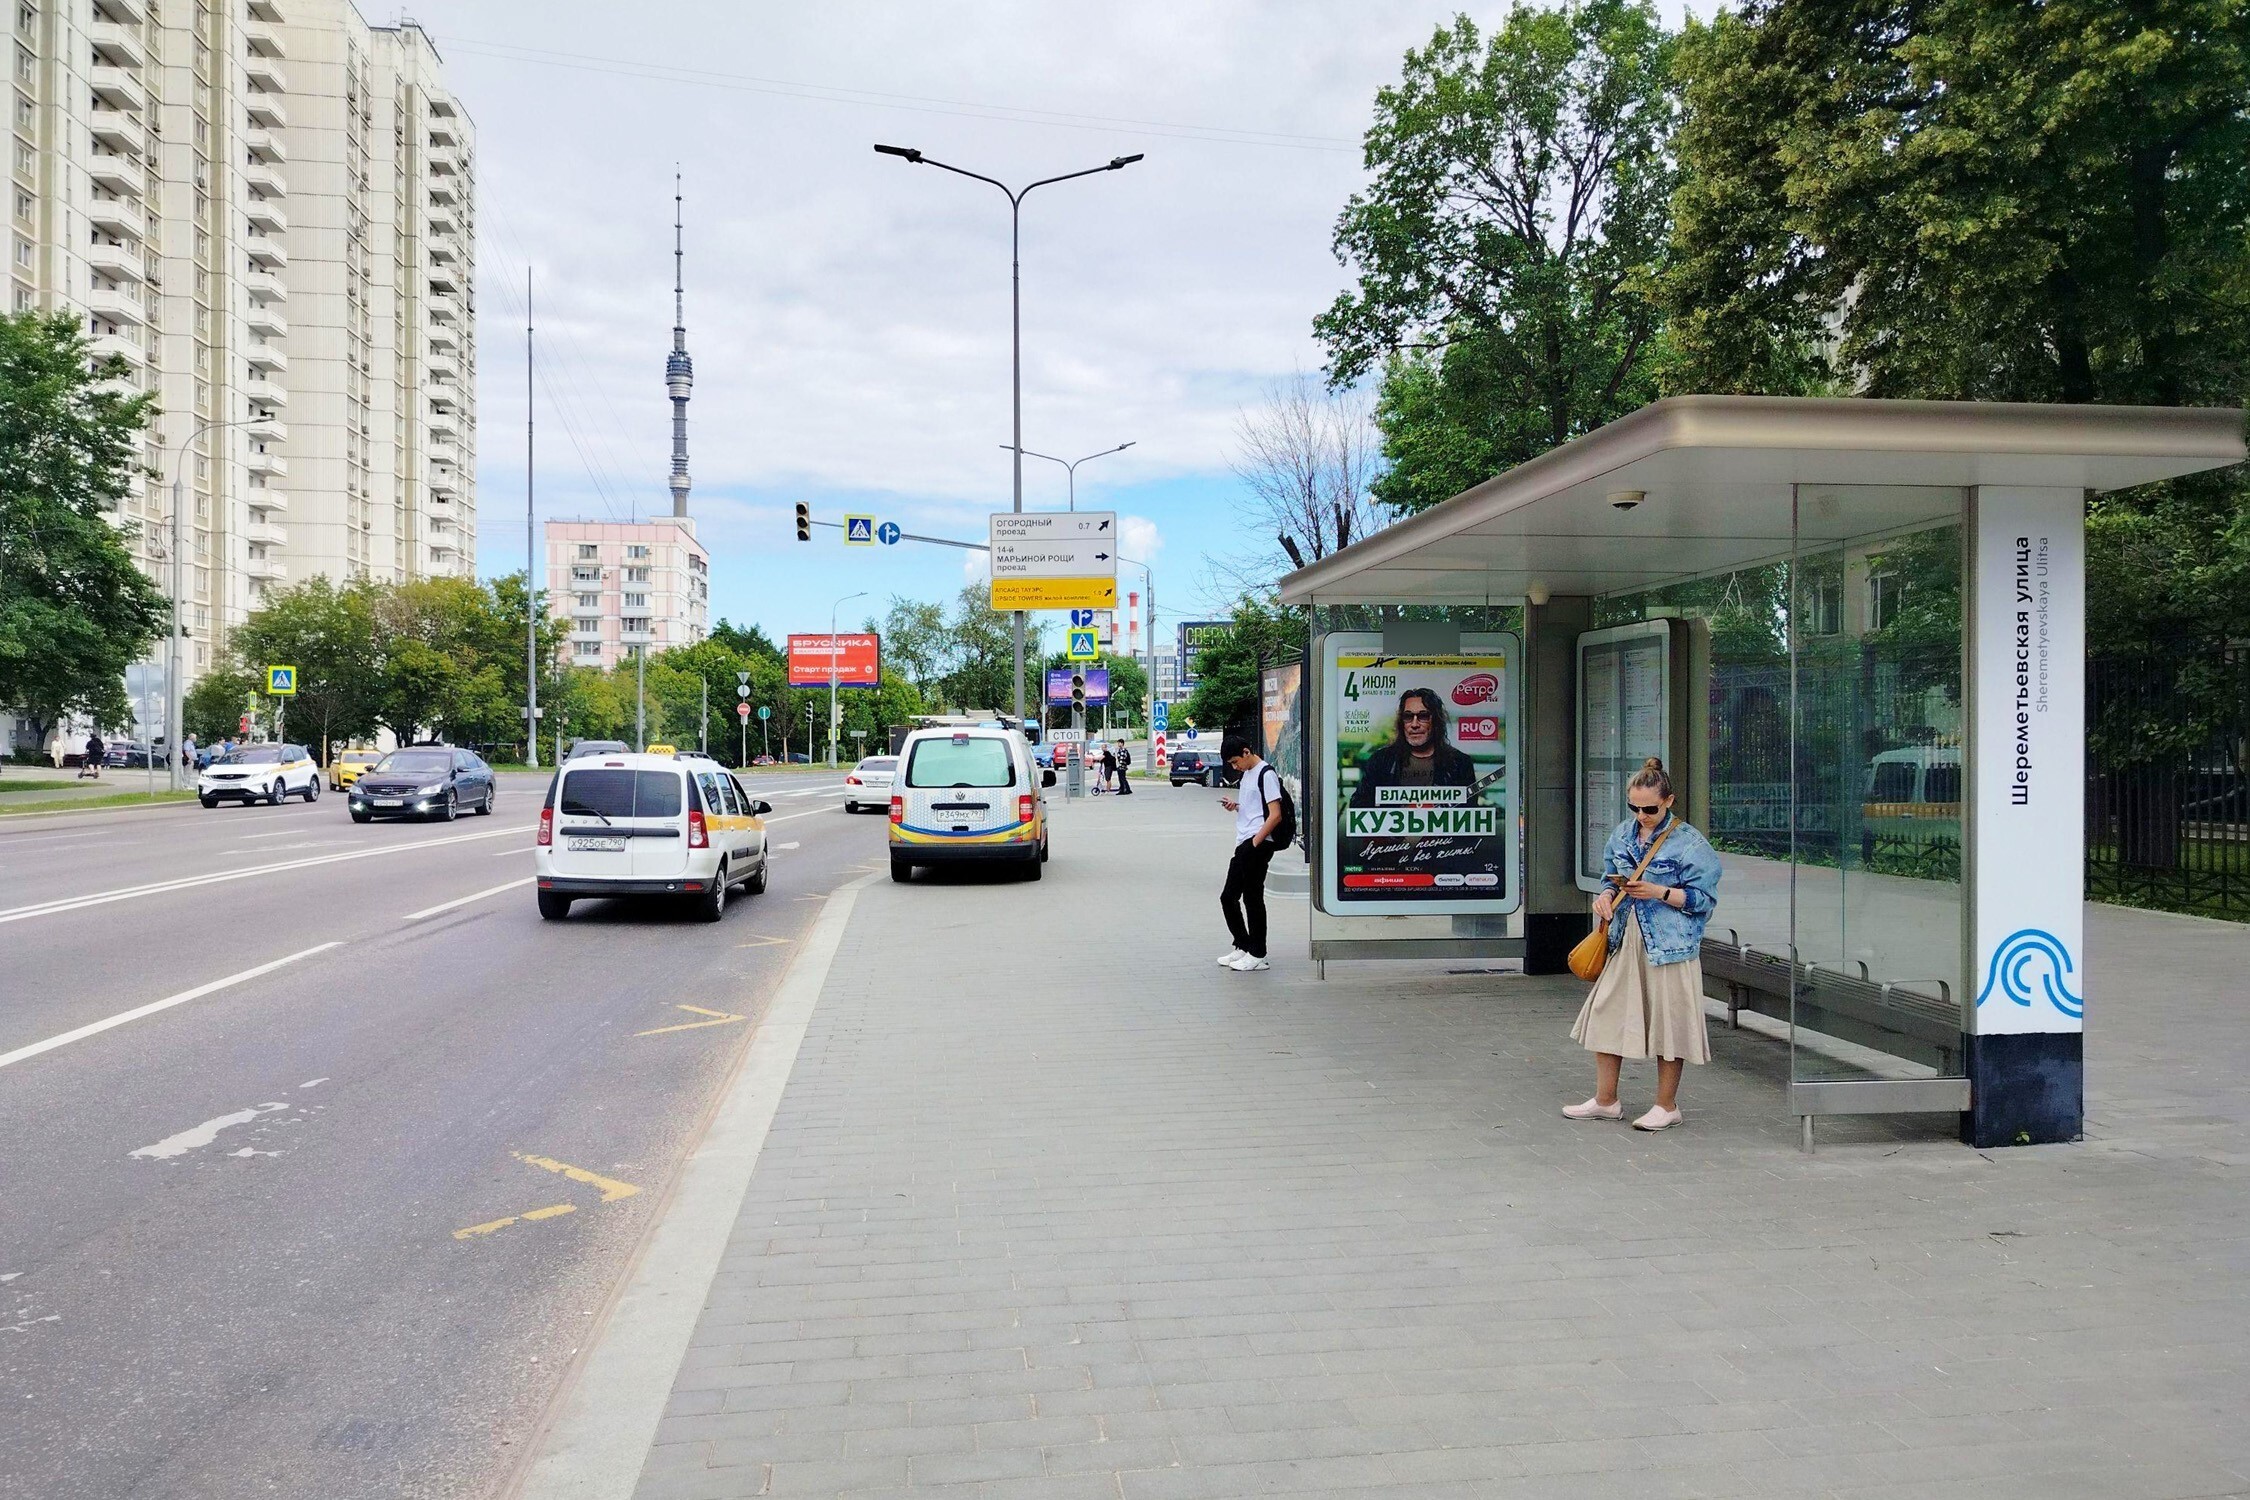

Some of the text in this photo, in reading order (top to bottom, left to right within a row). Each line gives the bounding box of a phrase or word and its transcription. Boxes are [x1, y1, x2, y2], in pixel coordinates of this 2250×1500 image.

[996, 518, 1052, 528] ОГОРОДНЫЙ
[1078, 522, 1091, 530] 0.7
[996, 528, 1027, 536] проезд
[997, 554, 1074, 563] МАРЬИНОЙ РОЩИ
[997, 564, 1027, 572] проезд
[2036, 536, 2050, 713] Sheremetyevskaya Ulitsa
[793, 639, 872, 647] БРУСНИКА
[793, 665, 820, 673] Старт
[2011, 536, 2033, 806] Шереметьевская улица
[1344, 671, 1396, 702] 4 ИЮЛЯ
[1456, 683, 1495, 697] Ретро
[1461, 722, 1479, 733] RU
[1053, 731, 1080, 740] СТОП
[1380, 789, 1462, 803] ВЛАДИМИР
[1350, 810, 1493, 834] КУЗЬМИН
[1359, 837, 1453, 860] Лучшие песни
[1398, 839, 1482, 864] и все хиты!
[1484, 863, 1499, 872] 12+
